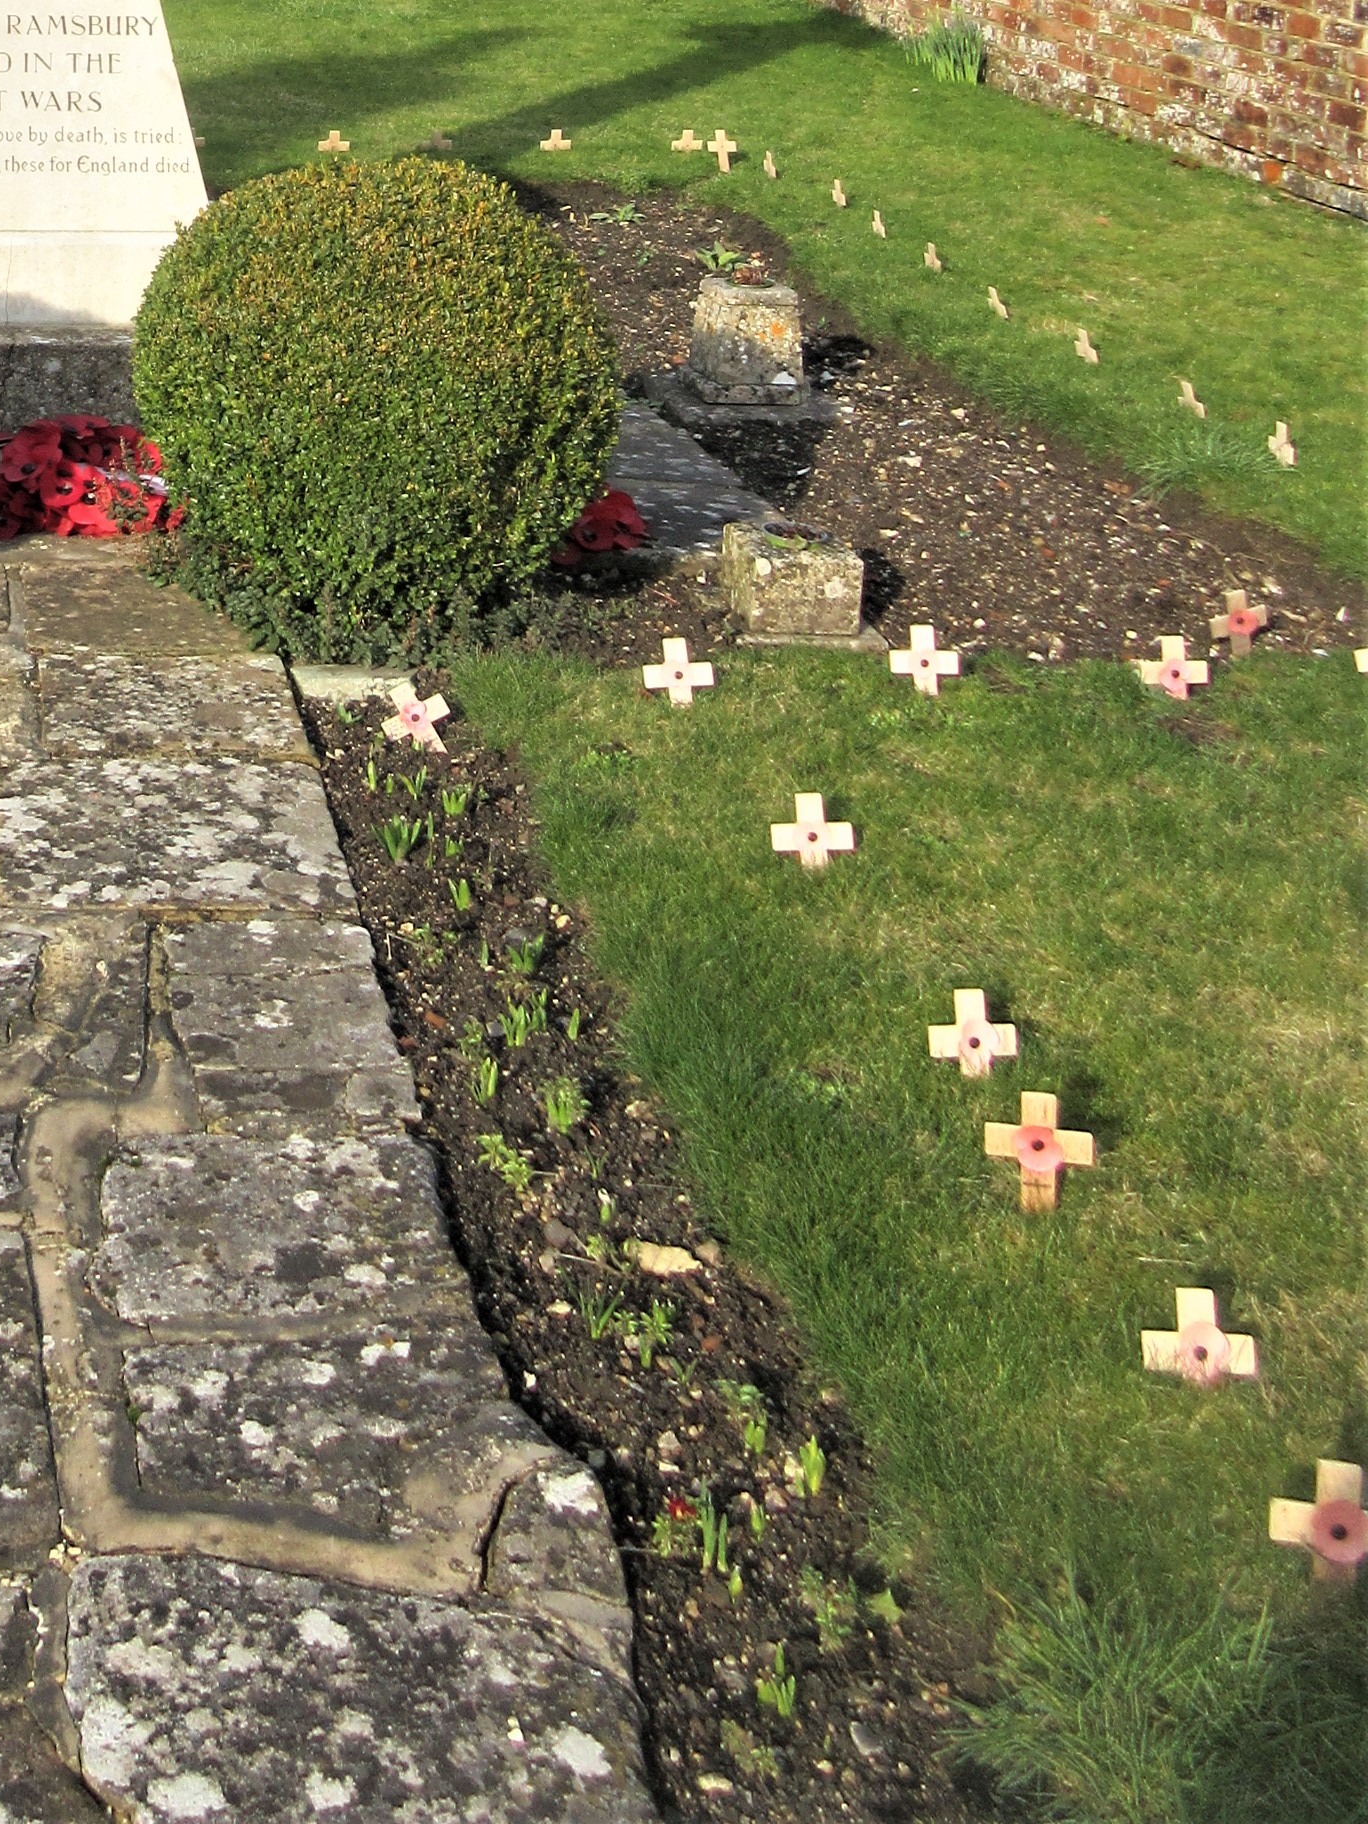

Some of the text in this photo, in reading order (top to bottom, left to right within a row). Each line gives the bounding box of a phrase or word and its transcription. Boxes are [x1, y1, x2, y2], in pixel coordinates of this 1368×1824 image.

[7, 14, 158, 36] RAMSBURY
[23, 52, 53, 73] IN
[66, 52, 122, 74] THE
[20, 90, 102, 112] WARS
[29, 125, 48, 145] by
[54, 126, 108, 145] death,
[113, 129, 127, 144] is
[5, 155, 45, 174] these
[50, 155, 73, 172] for
[77, 155, 149, 176] England
